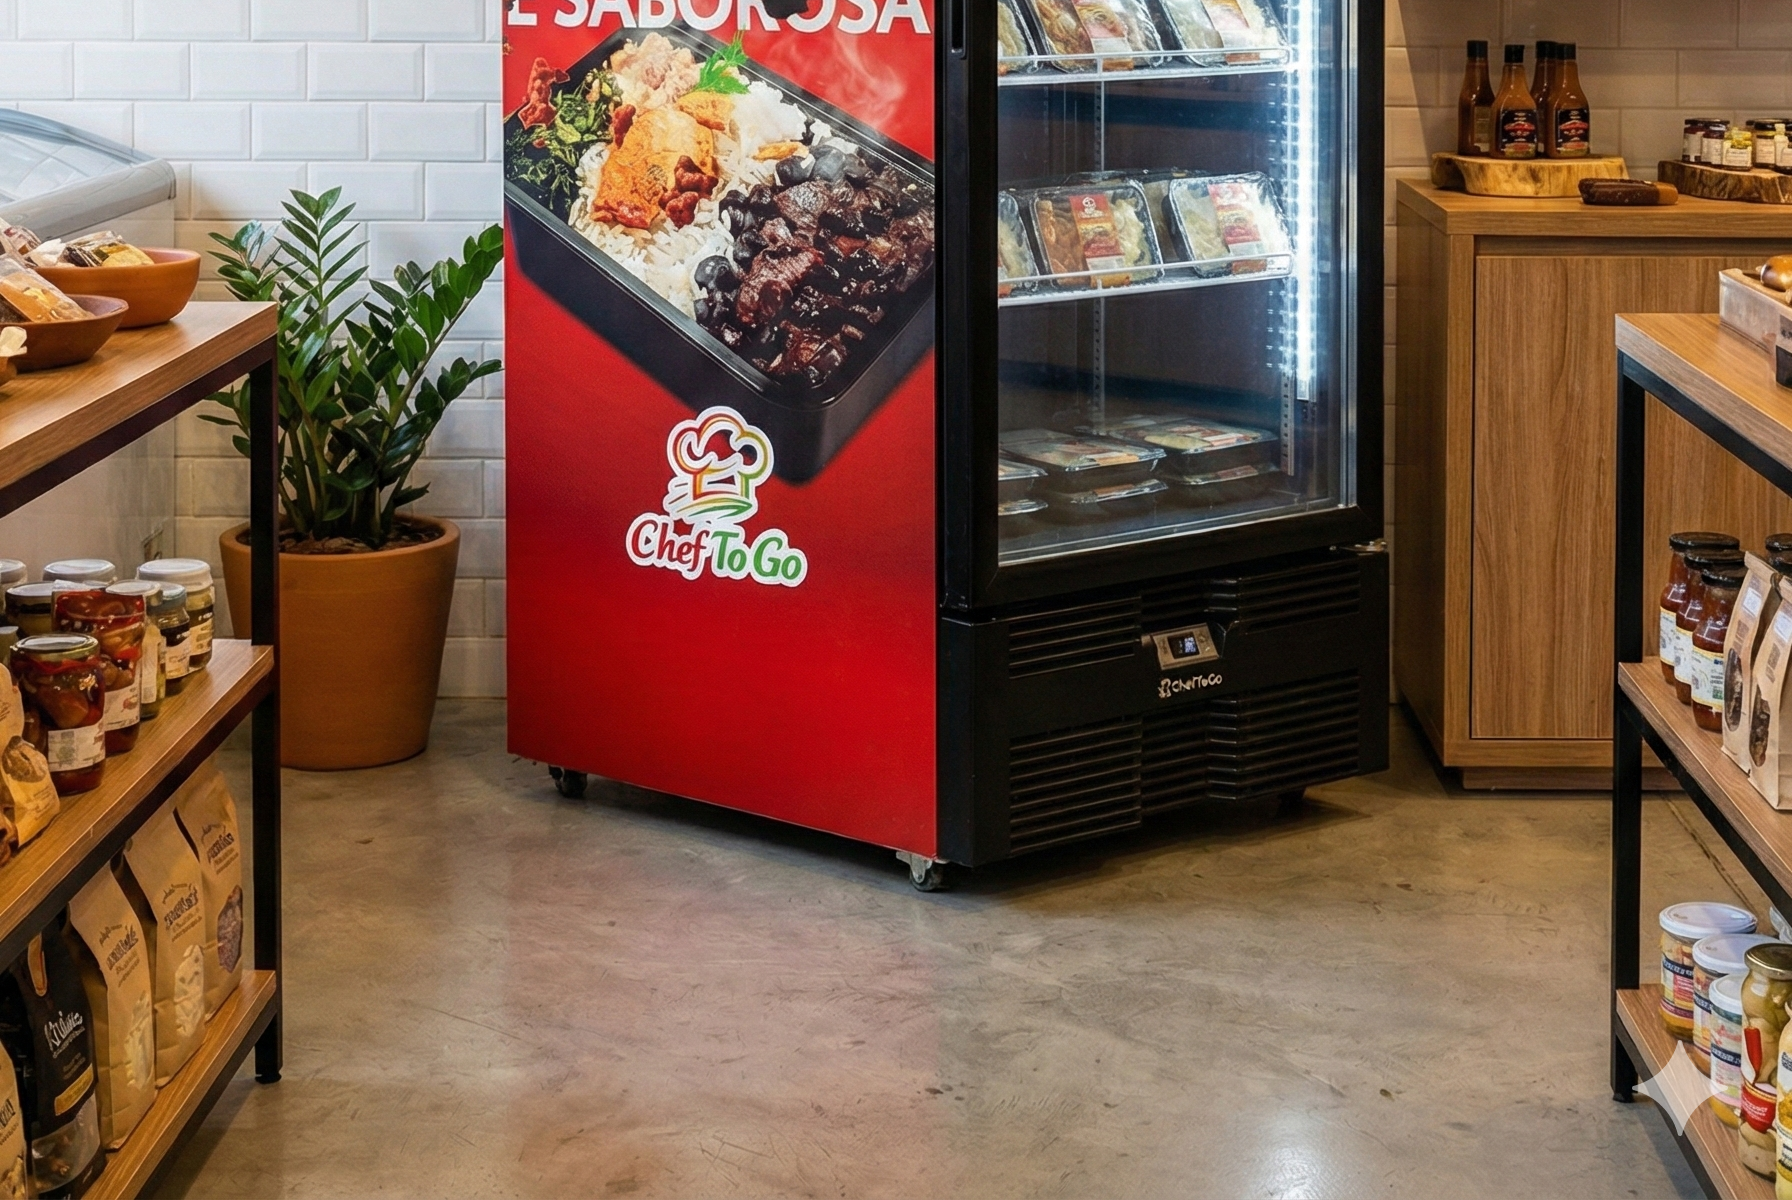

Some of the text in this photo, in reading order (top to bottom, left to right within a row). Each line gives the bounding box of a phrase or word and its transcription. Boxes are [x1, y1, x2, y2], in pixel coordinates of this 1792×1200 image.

[631, 519, 802, 580] Chef To Go
